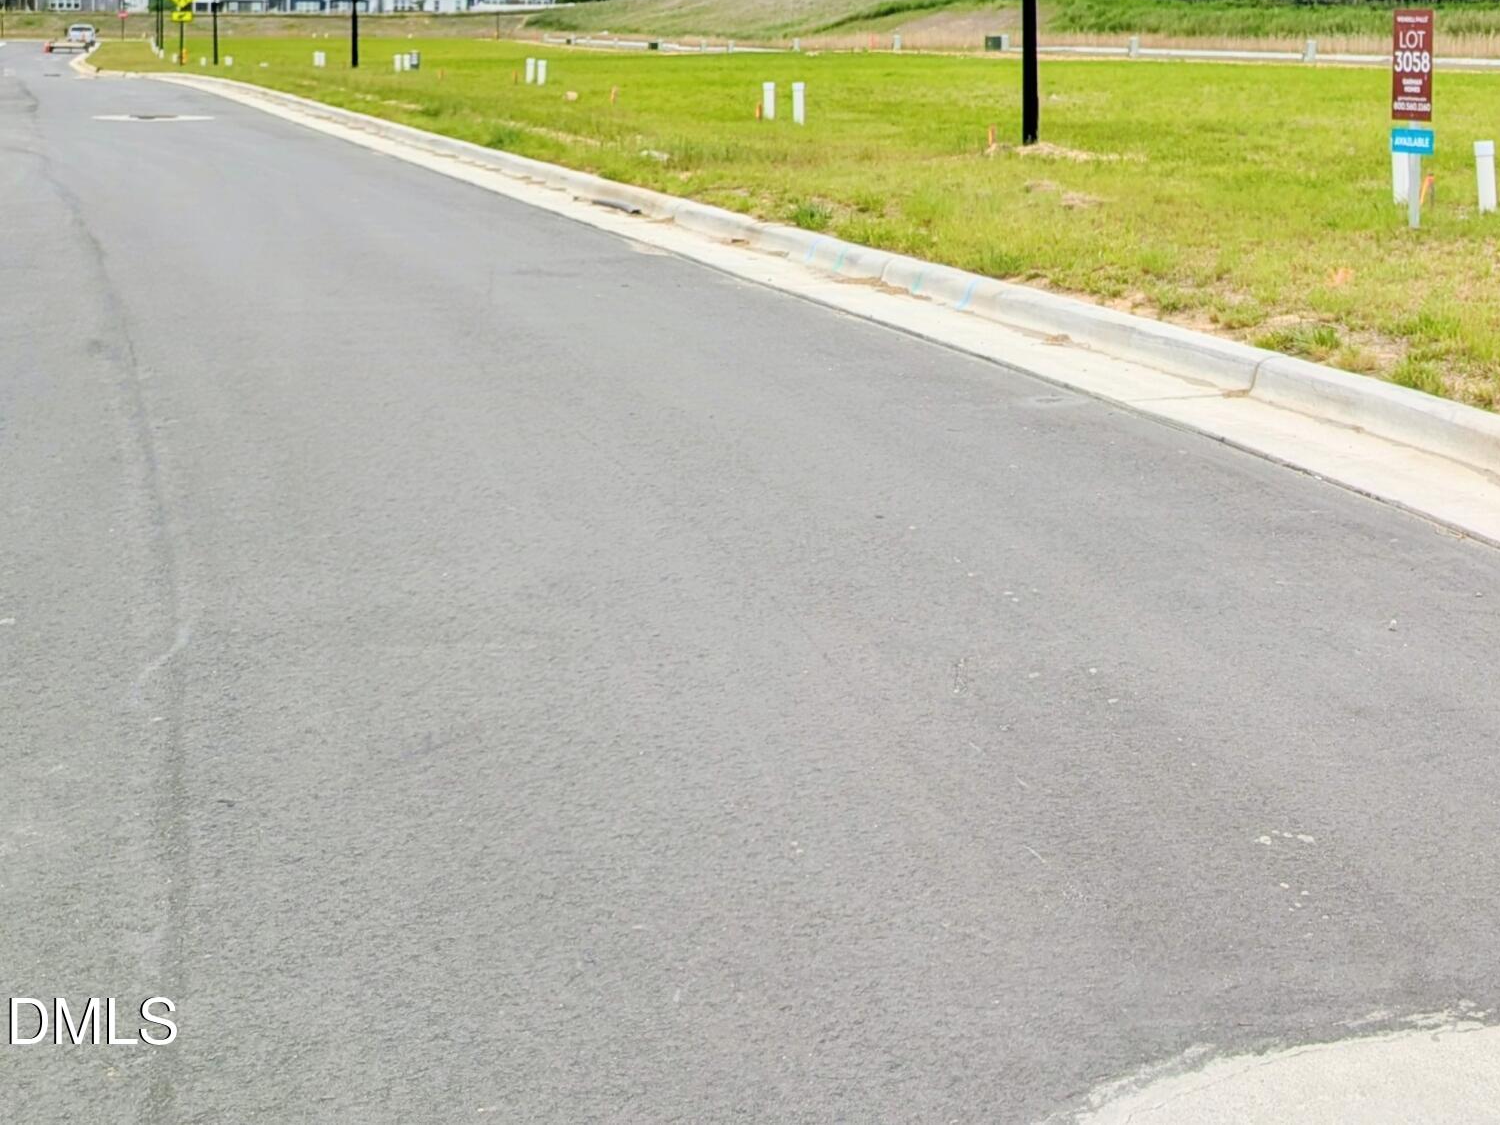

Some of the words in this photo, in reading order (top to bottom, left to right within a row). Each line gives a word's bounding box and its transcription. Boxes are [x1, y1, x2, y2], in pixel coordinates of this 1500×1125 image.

[1399, 30, 1426, 49] LOT
[1394, 51, 1430, 73] 3058
[1394, 136, 1430, 148] AVAILABLE
